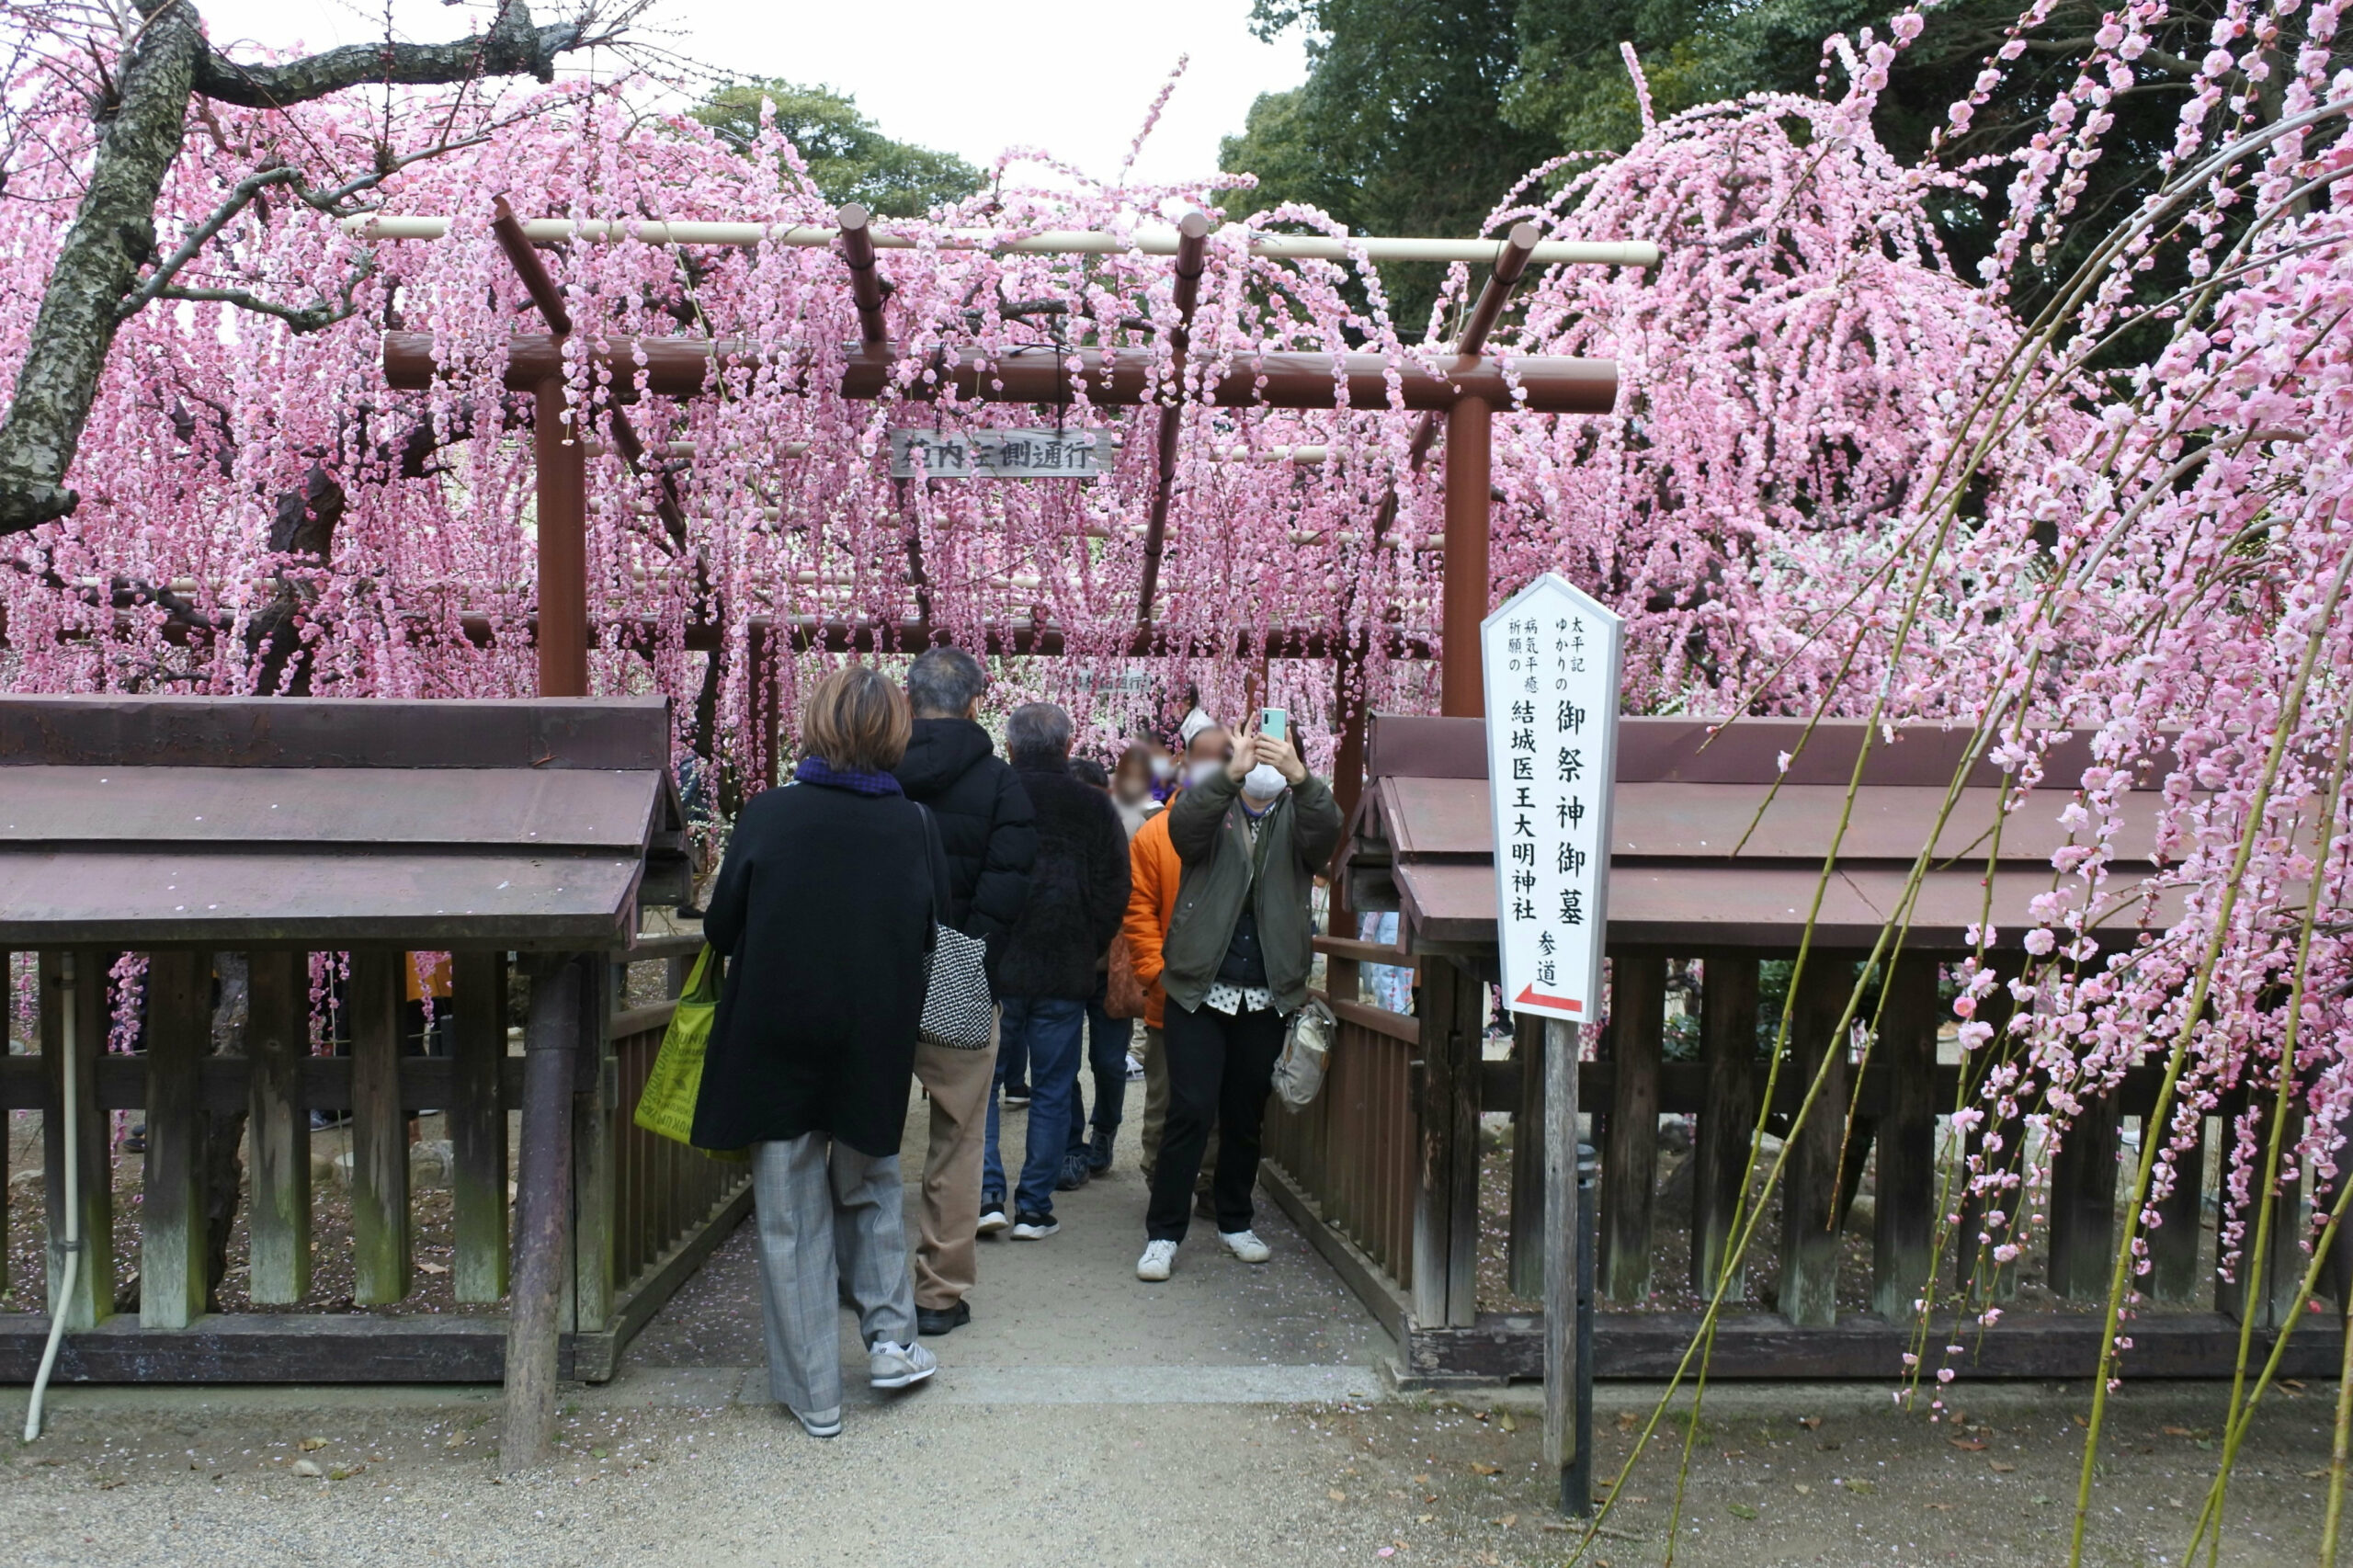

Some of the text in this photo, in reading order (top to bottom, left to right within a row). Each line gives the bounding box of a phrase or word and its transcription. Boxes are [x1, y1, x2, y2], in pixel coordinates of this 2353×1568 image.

[1508, 618, 1522, 672] 祈願の
[1524, 617, 1539, 694] 病気平癒
[1555, 618, 1568, 691] ゆかりの
[1570, 617, 1586, 673] 太平記
[1510, 699, 1538, 922] 結城医王大明神社
[1555, 699, 1586, 926] 御祭神御墓
[1536, 930, 1558, 987] 参道
